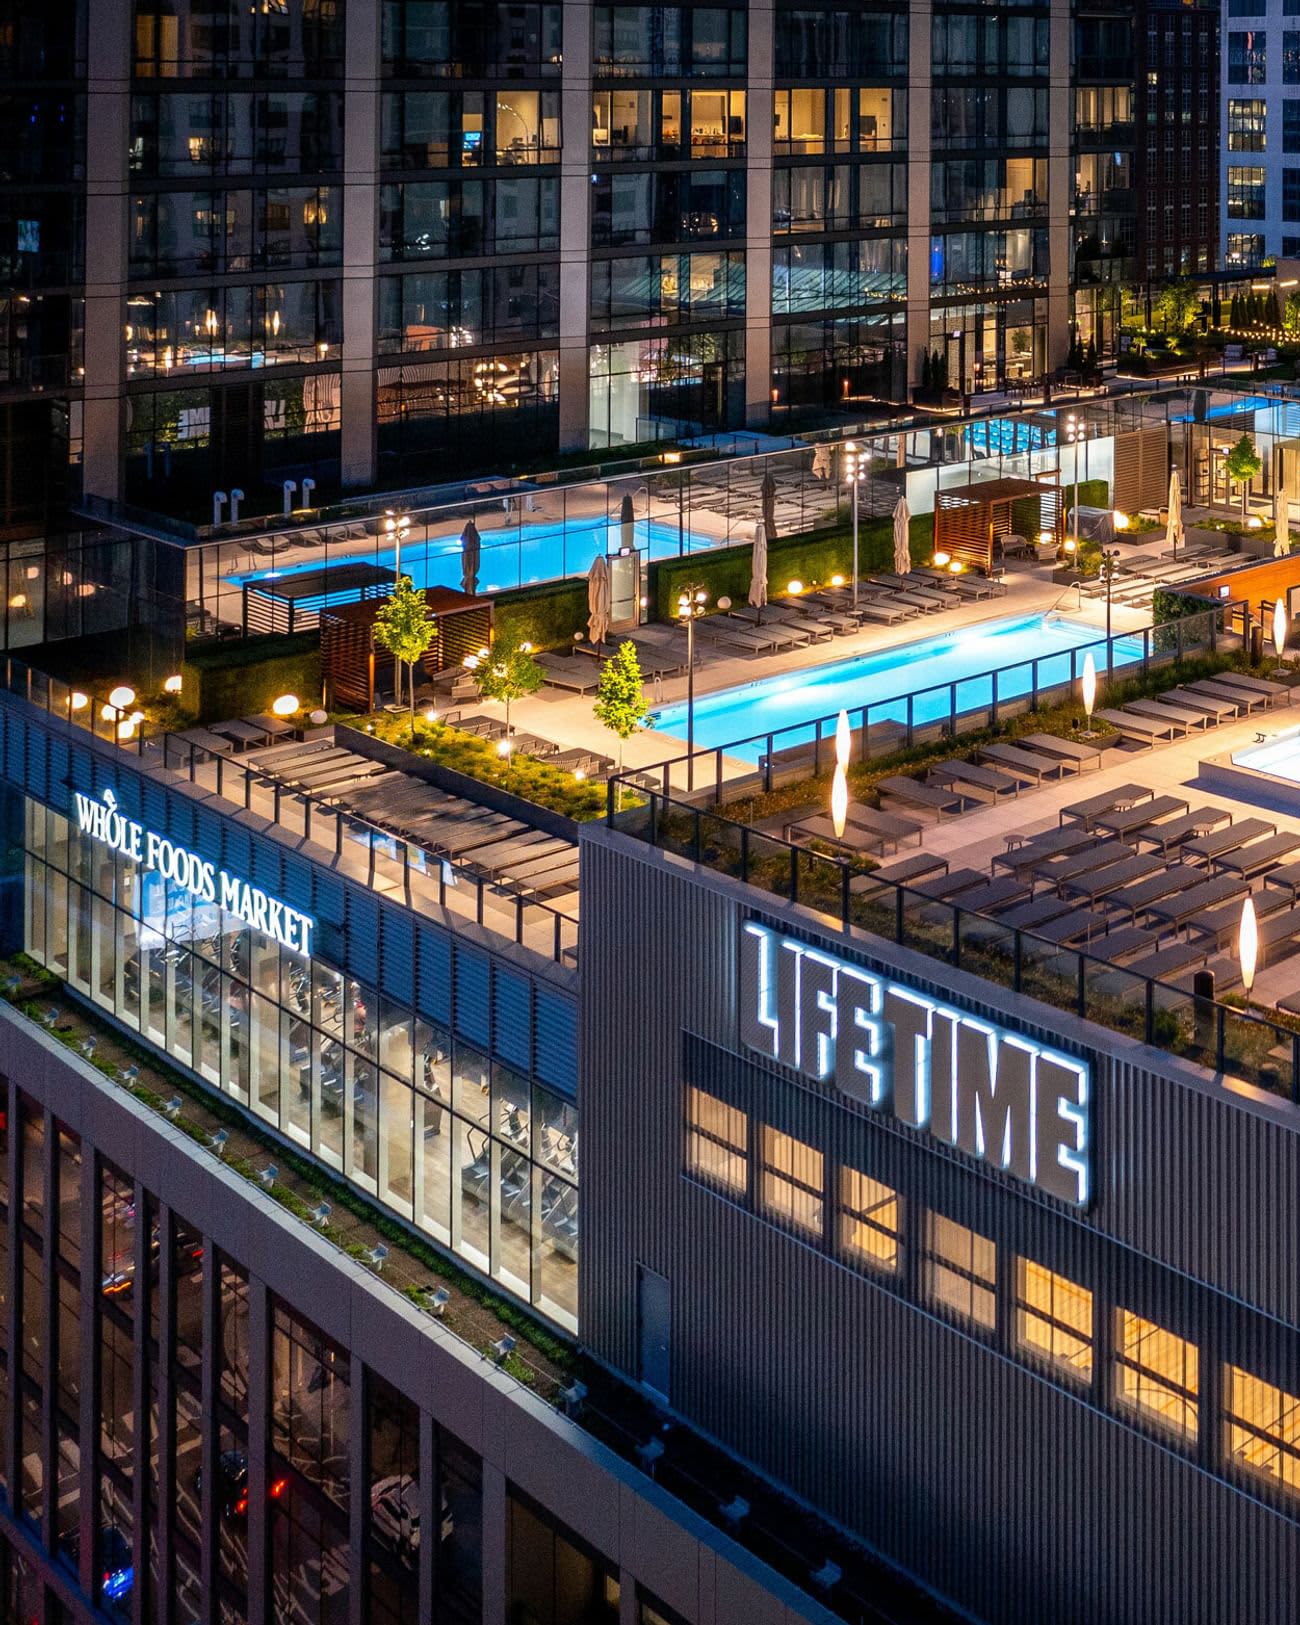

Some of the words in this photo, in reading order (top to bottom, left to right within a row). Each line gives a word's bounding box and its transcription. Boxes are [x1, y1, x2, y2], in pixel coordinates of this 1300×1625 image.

[75, 788, 143, 862] WHOLE
[146, 831, 216, 901] FOODS
[220, 871, 314, 958] MARKET
